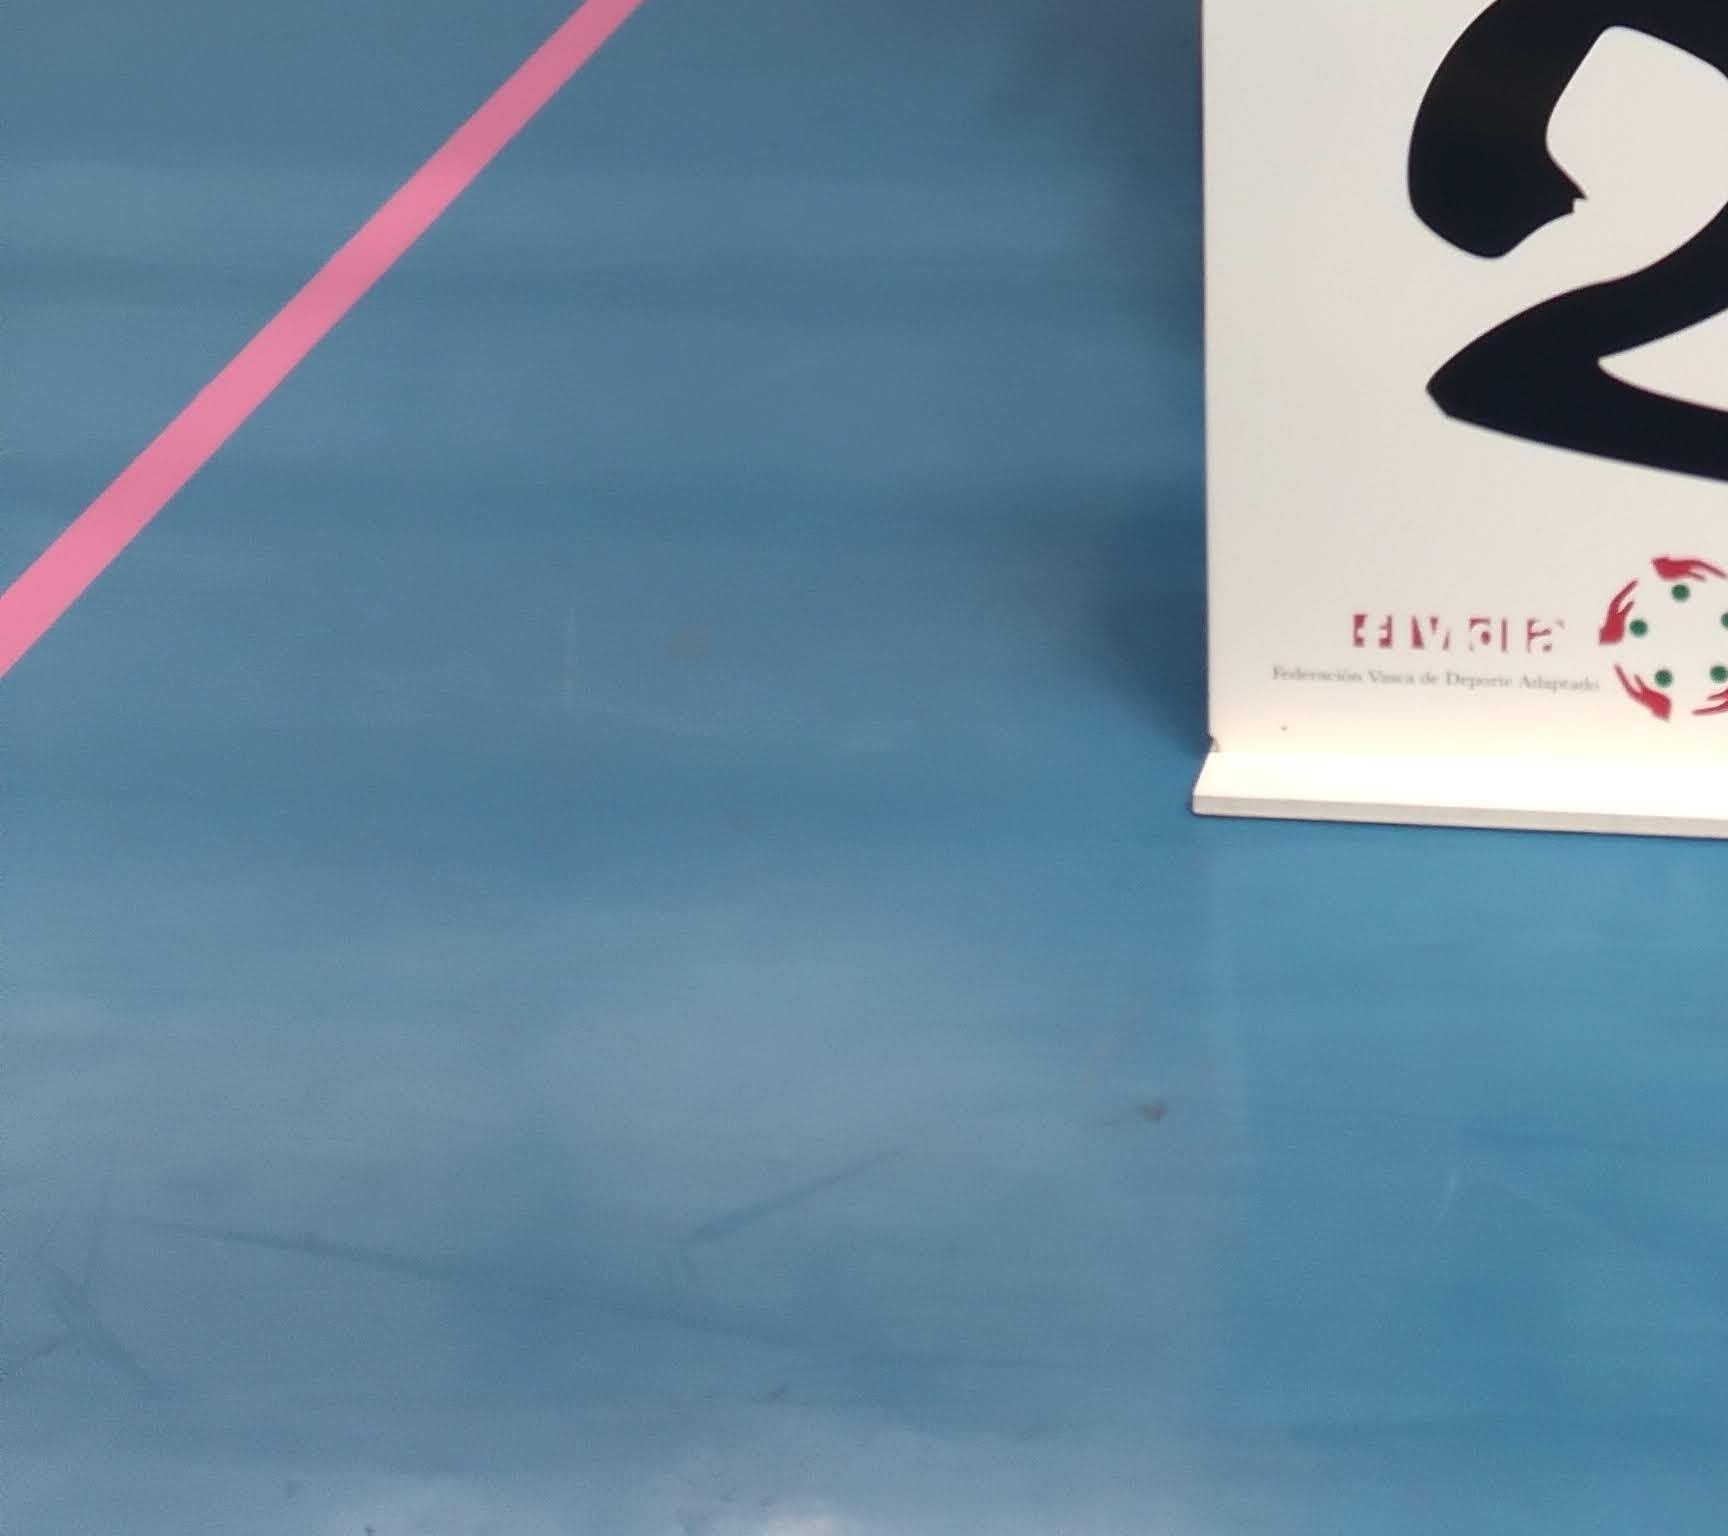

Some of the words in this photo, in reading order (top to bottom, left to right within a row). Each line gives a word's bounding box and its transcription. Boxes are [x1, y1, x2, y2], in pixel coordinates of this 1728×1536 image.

[1367, 669, 1414, 684] Vasca
[1420, 670, 1439, 685] de
[1446, 671, 1512, 690] Deporte
[1519, 674, 1601, 694] Adaptado
